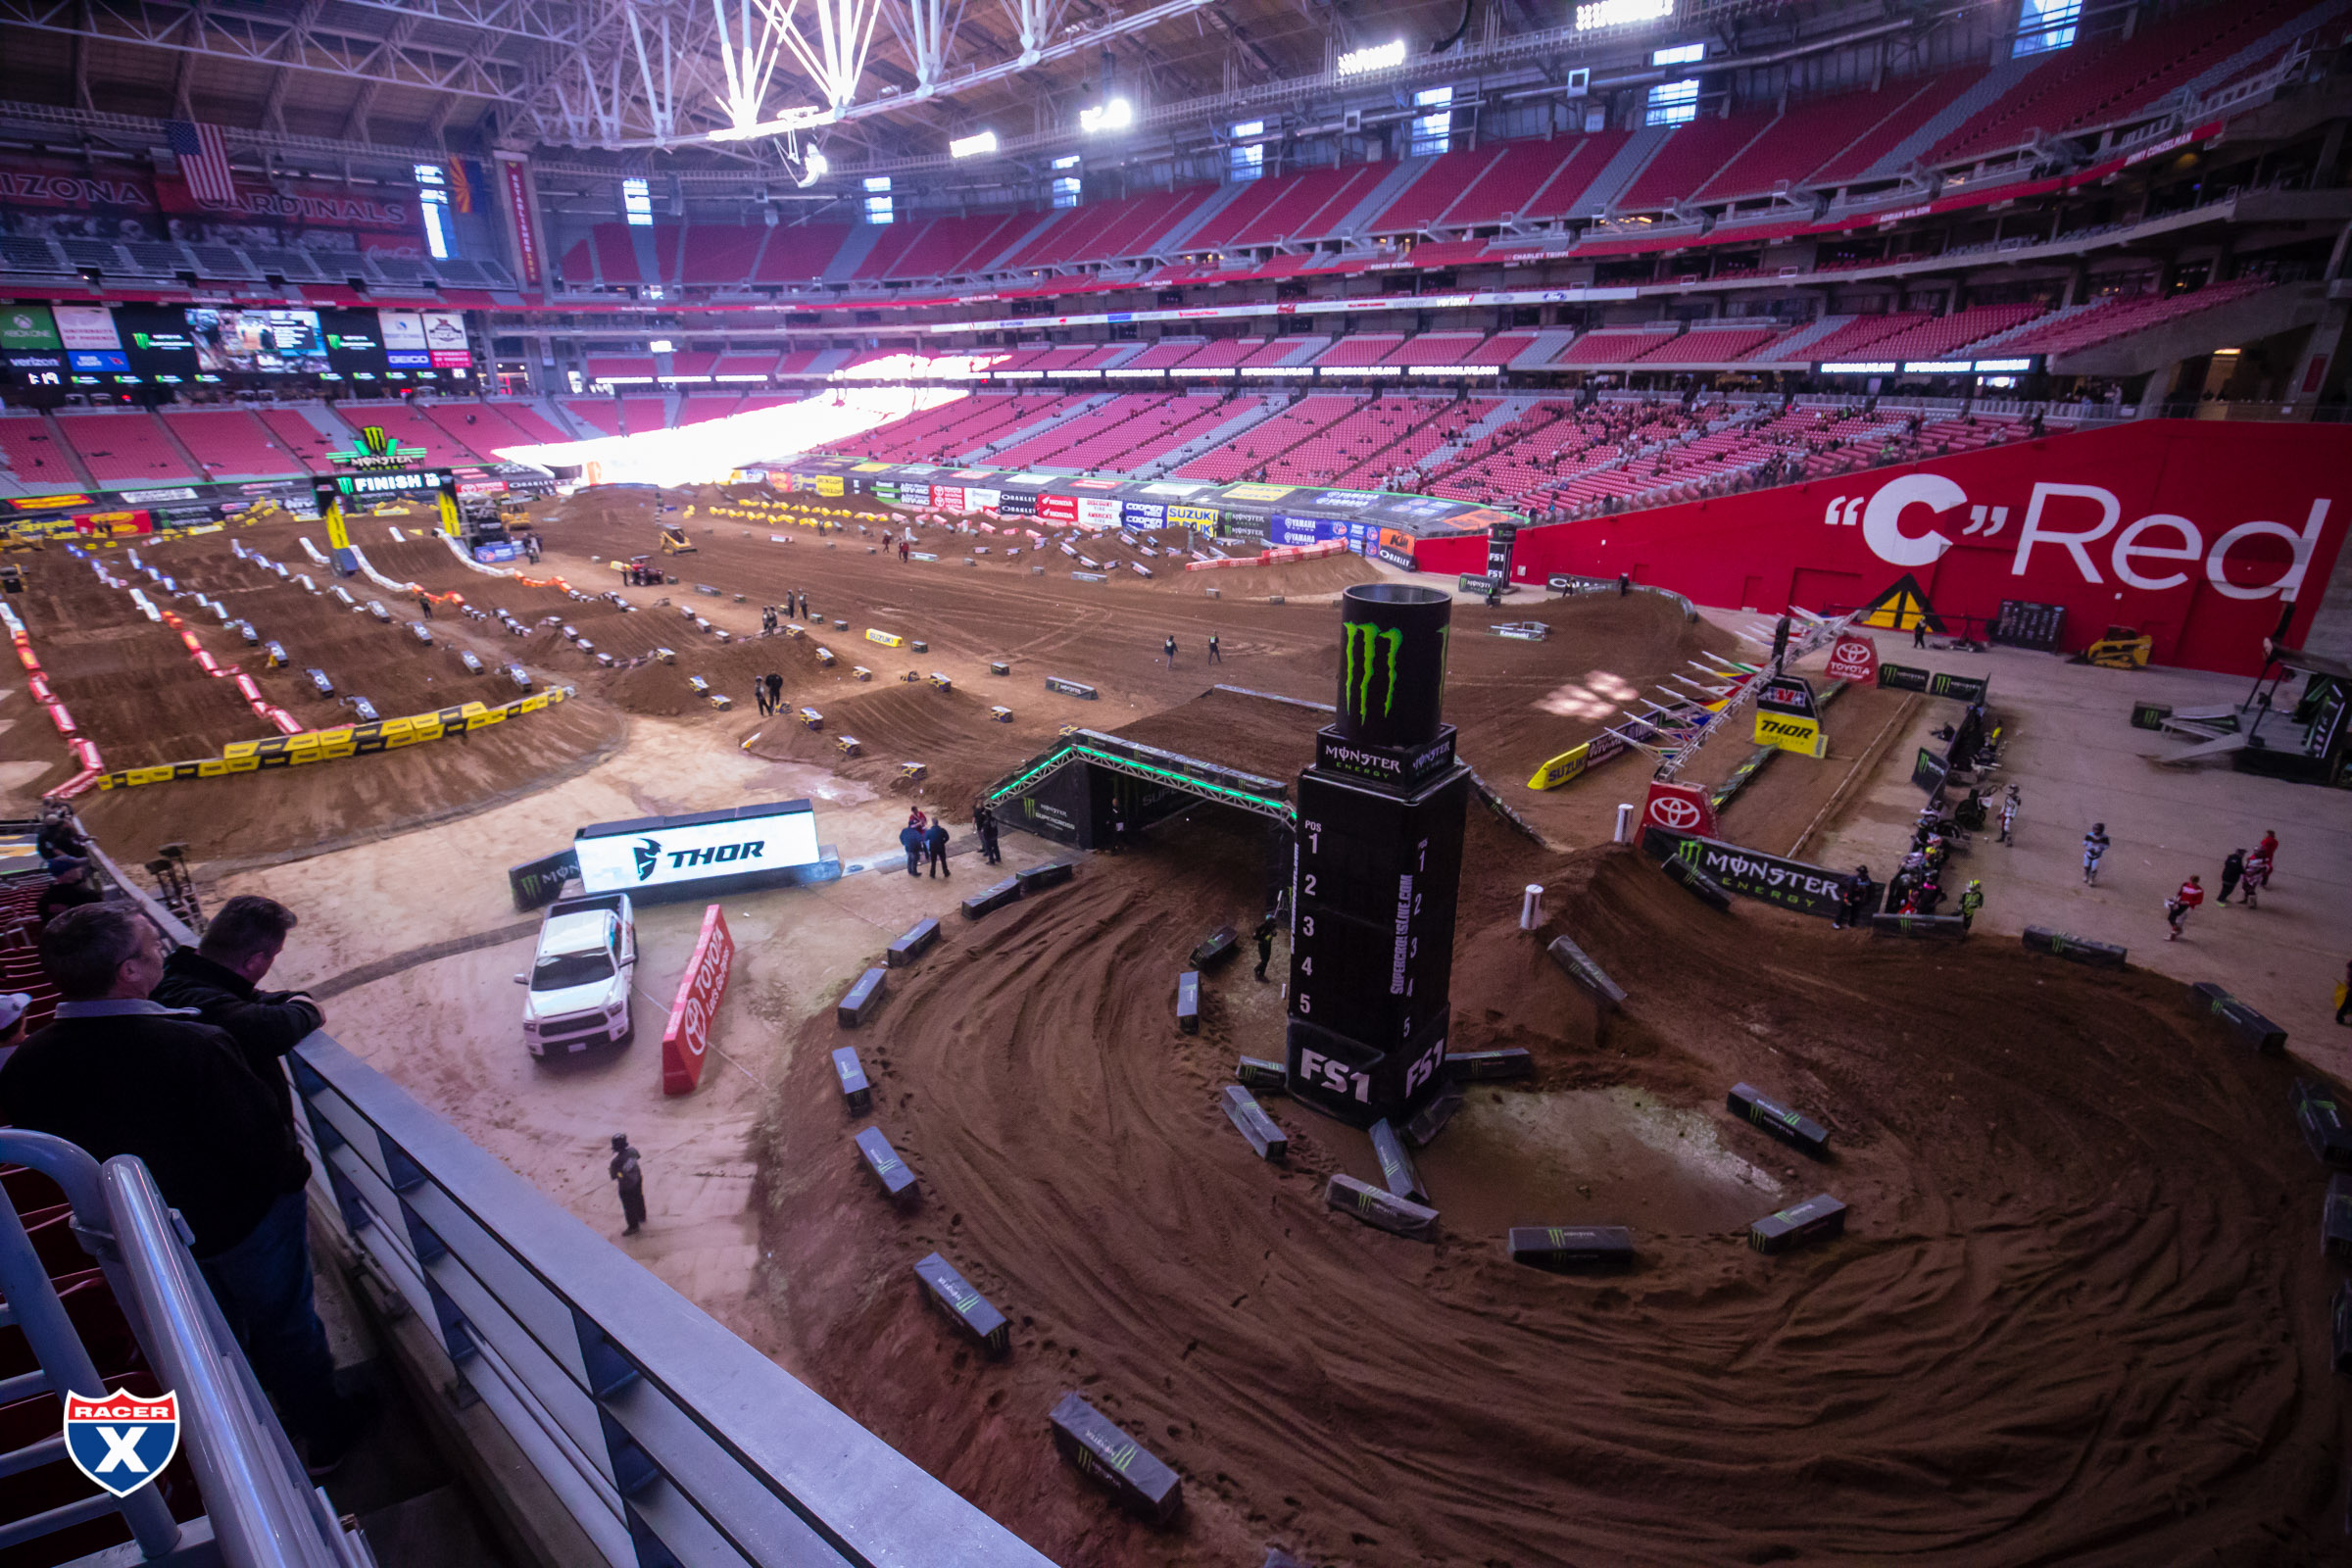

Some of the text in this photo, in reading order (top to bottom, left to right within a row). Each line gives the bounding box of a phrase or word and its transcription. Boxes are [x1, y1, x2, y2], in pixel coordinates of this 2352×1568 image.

[1513, 252, 1544, 261] CHARLEY
[1436, 296, 1470, 308] verizon
[10, 356, 60, 368] verizon
[388, 355, 429, 364] GEICO
[1408, 366, 1499, 375] SUPERCROSSLIVE.COM
[350, 455, 414, 467] MONSTER
[354, 474, 423, 492] FINISH
[1049, 511, 1074, 519] HONDA
[1126, 502, 1164, 513] COOPER
[1168, 508, 1218, 521] SUZUKI
[1126, 514, 1163, 526] COOPER
[1232, 513, 1265, 523] MONSTER
[1292, 518, 1316, 529] YAMAHA
[1231, 526, 1265, 537] MONSTER
[1292, 532, 1315, 544] YAMAHA
[1390, 533, 1409, 549] KTM
[2011, 482, 2331, 603] Red
[1489, 552, 1504, 563] FS1
[1488, 568, 1503, 579] FS1
[869, 632, 894, 644] SUZUKI
[1831, 662, 1870, 675] TOYOTA
[1760, 719, 1814, 740] THOR
[1325, 744, 1401, 774] MONSTER
[1336, 761, 1390, 780] ENERGY
[1041, 804, 1067, 817] MONSTER
[1035, 811, 1075, 830] SUPERCROSS
[1304, 819, 1322, 833] POS
[1308, 833, 1318, 855] 1
[667, 840, 765, 868] THOR
[1419, 851, 1426, 872] 1
[1304, 873, 1317, 897] 2
[1705, 851, 1840, 902] MONSTER
[1722, 876, 1816, 908] ENERGY
[1413, 893, 1422, 916] 2
[1302, 915, 1315, 938] 3
[1409, 936, 1418, 958] 3
[695, 924, 725, 1000] TOYOTA
[1300, 956, 1313, 976] 4
[1406, 978, 1414, 998] 4
[1299, 994, 1311, 1014] 5
[1402, 1016, 1411, 1039] 5
[1299, 1047, 1371, 1104] FS1
[1404, 1038, 1446, 1099] FS1
